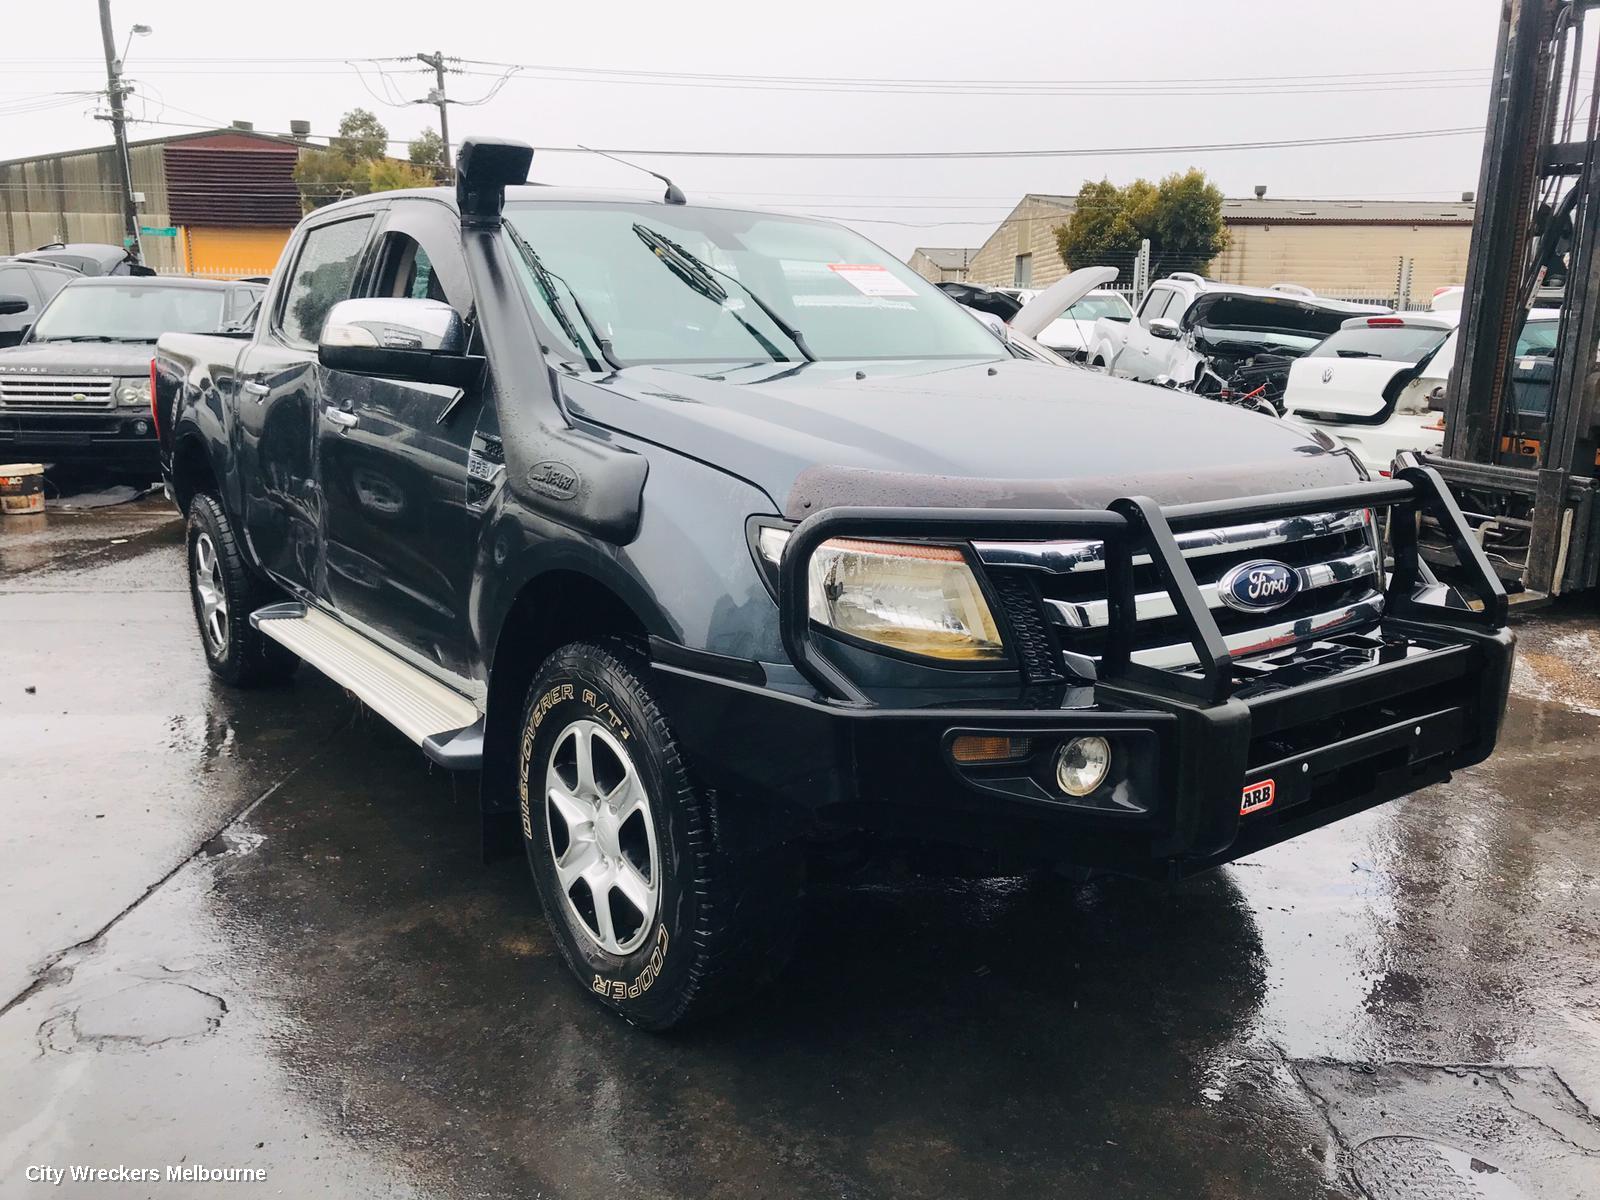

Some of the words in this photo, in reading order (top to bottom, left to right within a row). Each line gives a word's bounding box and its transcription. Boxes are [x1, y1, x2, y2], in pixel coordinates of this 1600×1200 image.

[1248, 568, 1289, 599] Ford
[520, 683, 574, 840] DISCOVERER
[1242, 785, 1271, 810] ARB
[592, 922, 669, 999] COOPER
